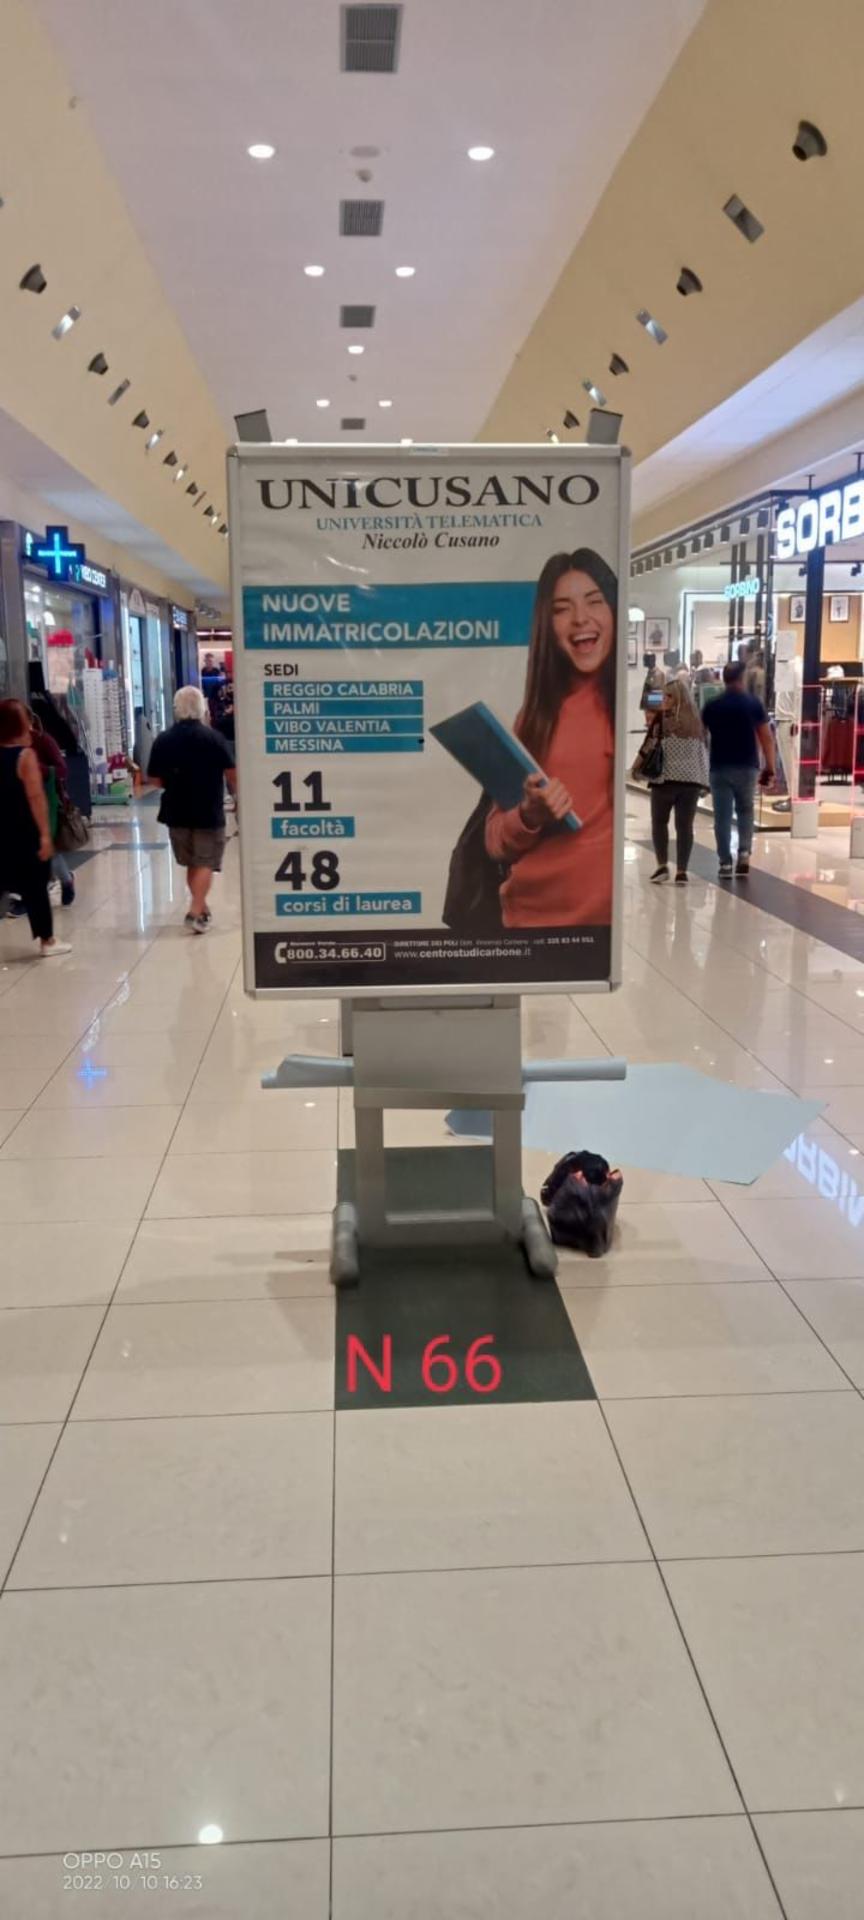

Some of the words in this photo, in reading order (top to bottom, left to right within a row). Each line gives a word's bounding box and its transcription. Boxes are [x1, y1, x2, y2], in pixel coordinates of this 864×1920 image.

[256, 475, 599, 510] UNICUSANO
[316, 513, 425, 531] UNIVERSITÀ
[429, 513, 543, 529] TELEMATICA
[777, 480, 864, 559] SORB
[361, 533, 427, 550] Niccolò
[435, 533, 500, 549] Cusano
[262, 593, 350, 613] NUOVE
[263, 620, 499, 642] IMMATRICOLAZIONI
[264, 664, 299, 676] SEDI
[273, 684, 333, 697] REGGIO
[337, 683, 413, 696] CALABRIA
[273, 702, 320, 715] PALMI
[274, 720, 311, 733] VIBO
[316, 720, 391, 733] VALENTIA
[275, 738, 344, 751] MESSINA
[272, 770, 331, 811] 11
[280, 818, 345, 837] facoltà
[274, 851, 340, 891] 48
[283, 897, 326, 913] corsi
[332, 896, 350, 912] di
[356, 895, 412, 911] laurea
[287, 947, 382, 959] 800.34.66.40
[394, 947, 531, 958] www.centrostudicarbone.it
